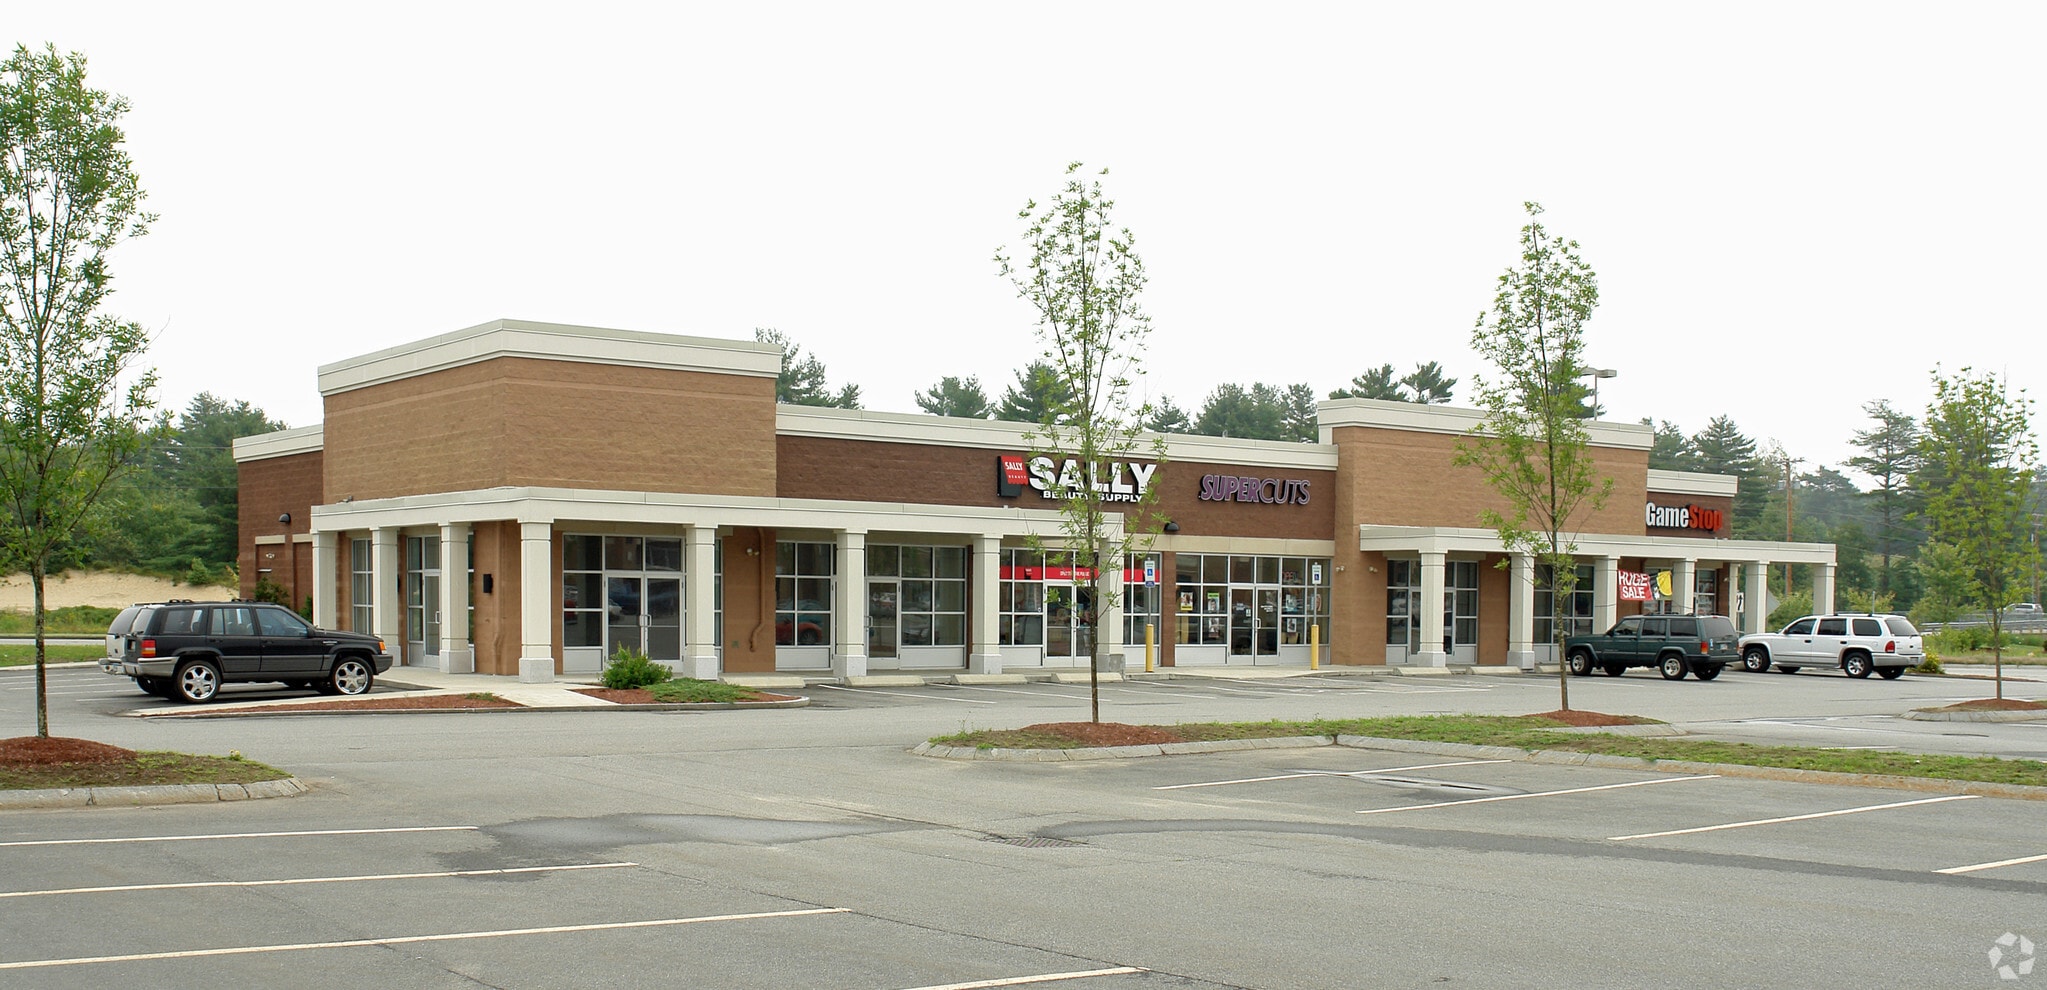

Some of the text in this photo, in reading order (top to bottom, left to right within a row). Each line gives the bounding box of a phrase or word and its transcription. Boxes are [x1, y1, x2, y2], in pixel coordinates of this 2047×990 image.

[1004, 461, 1023, 471] SALLY
[1029, 457, 1157, 494] SALLY
[1098, 492, 1143, 503] SUPPLY
[1200, 474, 1311, 505] SUPERCUTS
[1645, 502, 1723, 532] GameStop
[1618, 569, 1649, 586] HUGE
[1622, 586, 1646, 599] SALE
